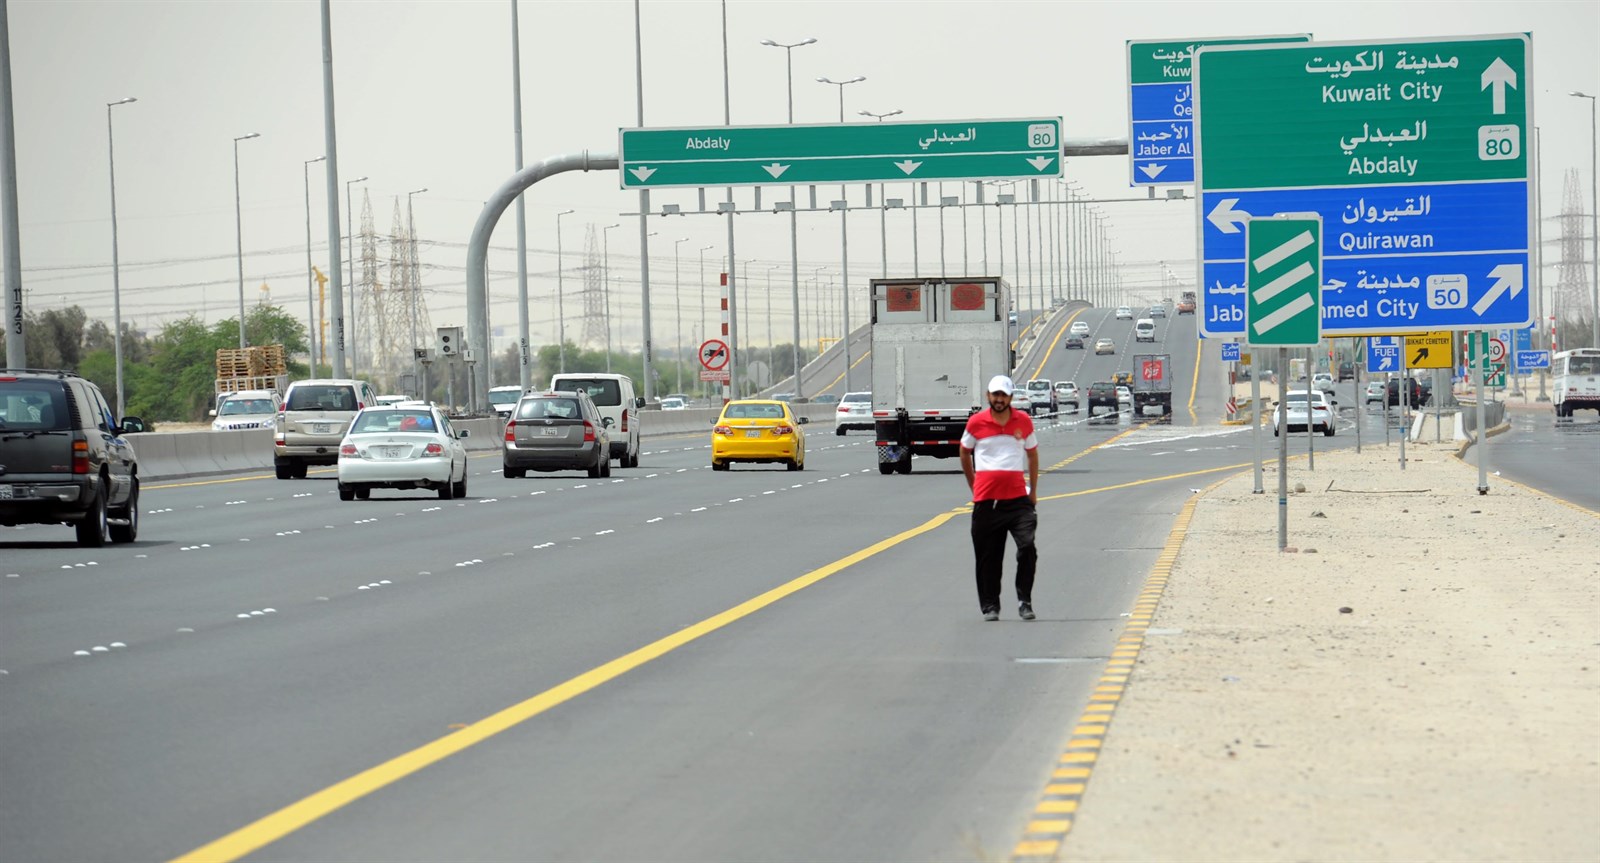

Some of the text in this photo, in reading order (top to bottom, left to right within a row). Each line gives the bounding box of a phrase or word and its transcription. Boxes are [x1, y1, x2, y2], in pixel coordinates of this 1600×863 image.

[1163, 65, 1191, 77] Kuw
[1305, 50, 1459, 78] مدينة الكويت
[1175, 85, 1192, 103] ان
[1322, 81, 1443, 103] Kuwait City
[1173, 104, 1192, 117] Qe
[686, 136, 731, 151] Abdaly
[918, 127, 977, 150] العبدلي
[1033, 133, 1051, 145] 80
[1339, 119, 1427, 155] العبدلي
[1137, 142, 1191, 156] Jaber Al
[1486, 138, 1513, 156] 80
[1348, 156, 1418, 176] Abdaly
[1342, 194, 1431, 225] القيروان
[1339, 231, 1434, 252] Quirawan
[1322, 278, 1347, 294] ج
[1356, 269, 1420, 295] مدينة
[1434, 288, 1461, 306] 50
[1209, 304, 1245, 322] Jab
[1376, 298, 1420, 320] City
[1374, 348, 1398, 357] FUEL
